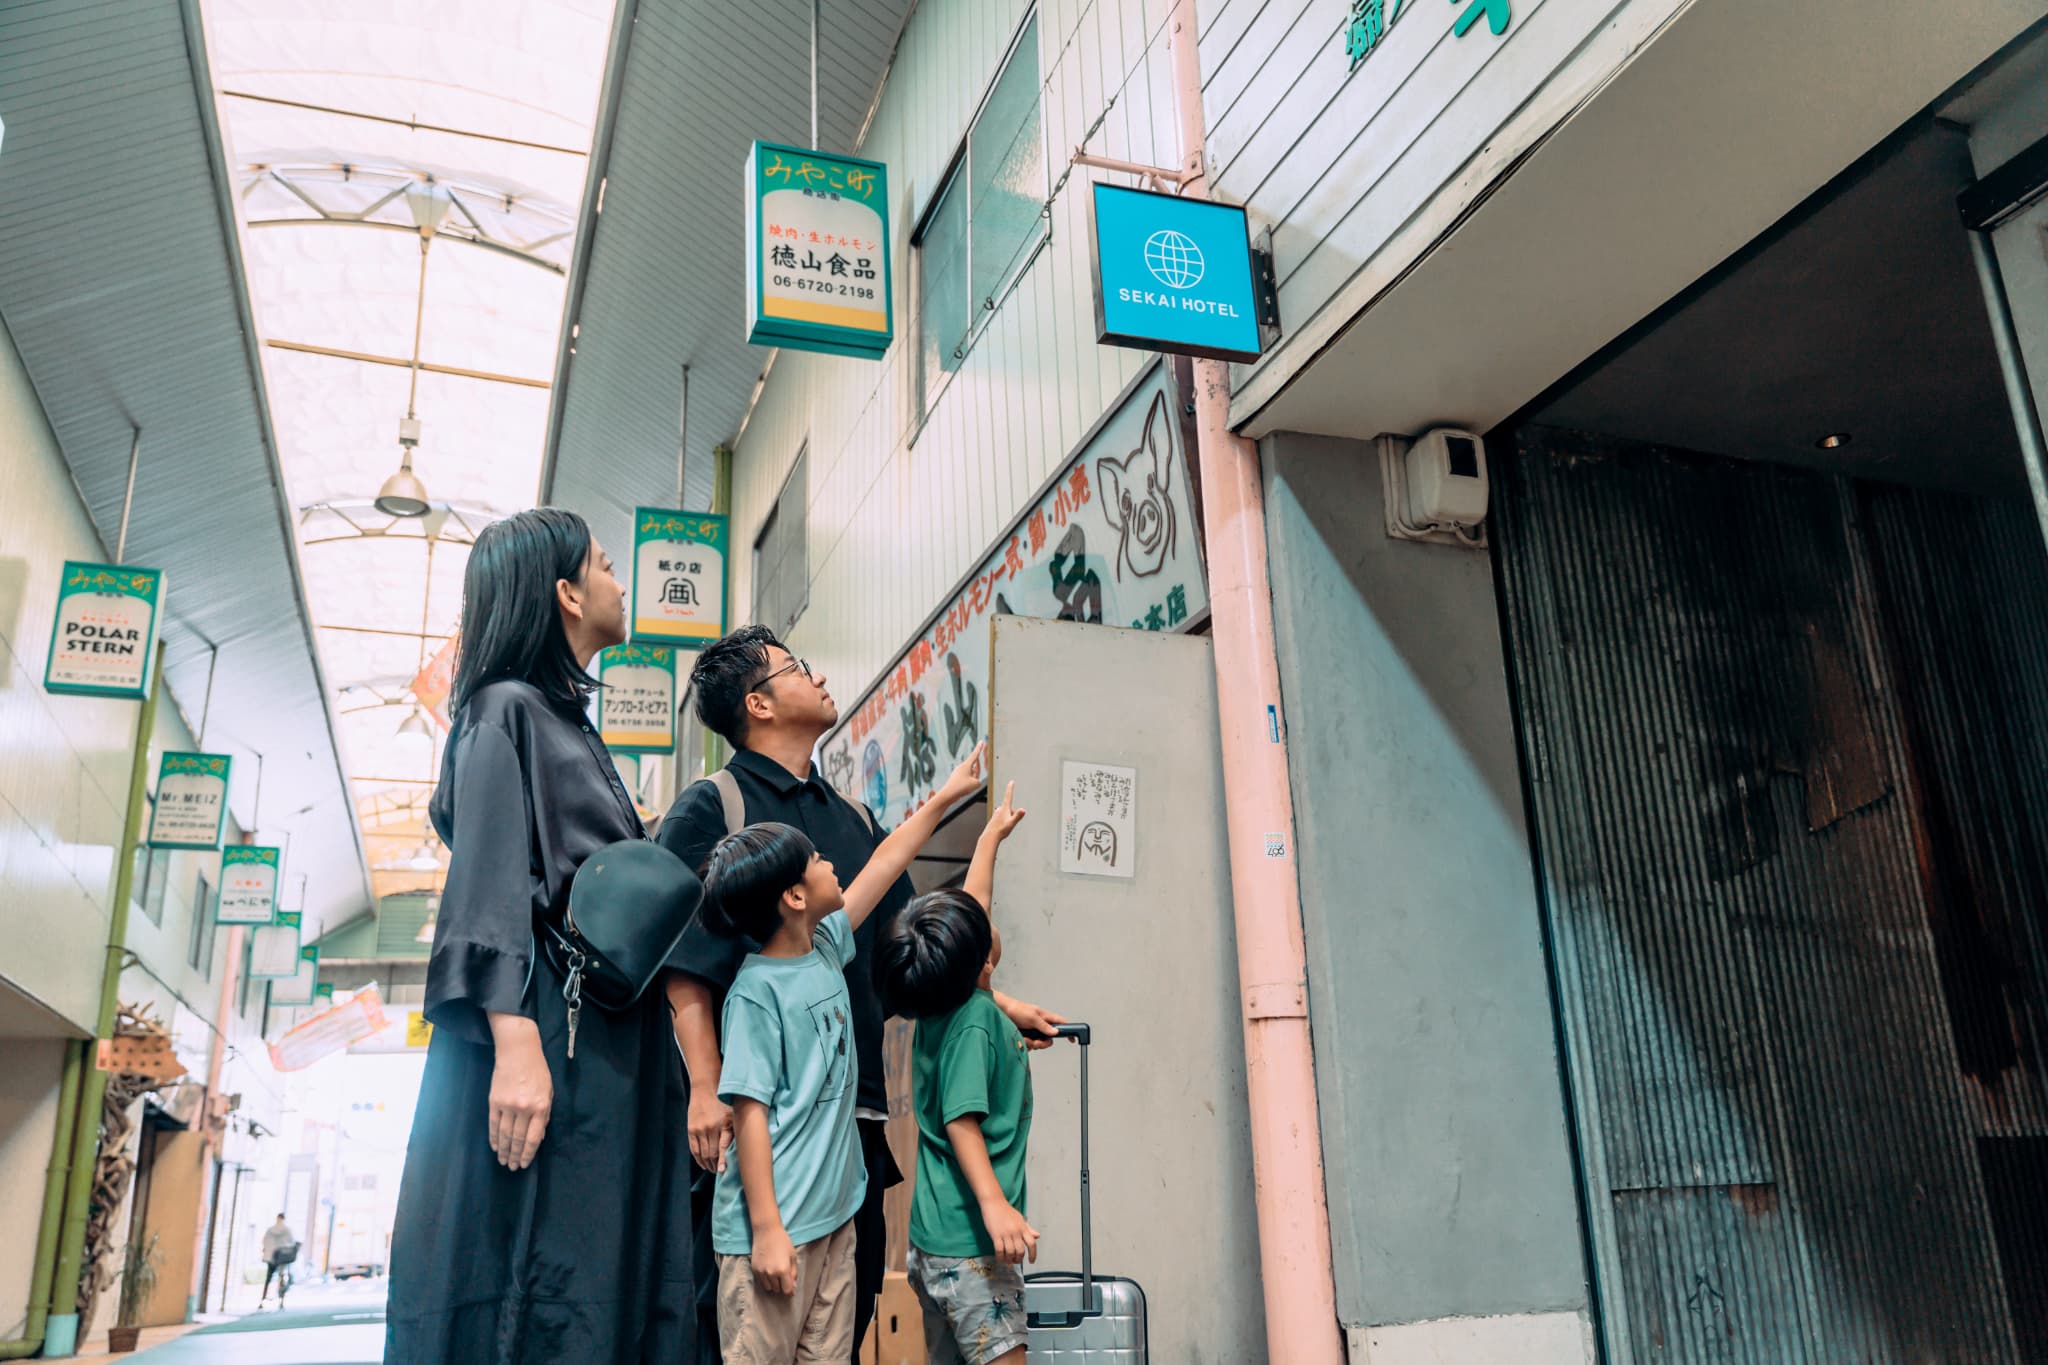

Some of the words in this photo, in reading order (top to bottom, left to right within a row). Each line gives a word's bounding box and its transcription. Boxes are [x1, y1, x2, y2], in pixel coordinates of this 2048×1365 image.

[765, 155, 876, 199] みやこ町
[771, 244, 876, 280] 徳山食品
[773, 275, 874, 299] 06-6720-2198
[1119, 288, 1176, 309] SEKAI
[1182, 297, 1239, 318] HOTEL
[65, 622, 140, 641] POLAR
[66, 639, 135, 655] STERN
